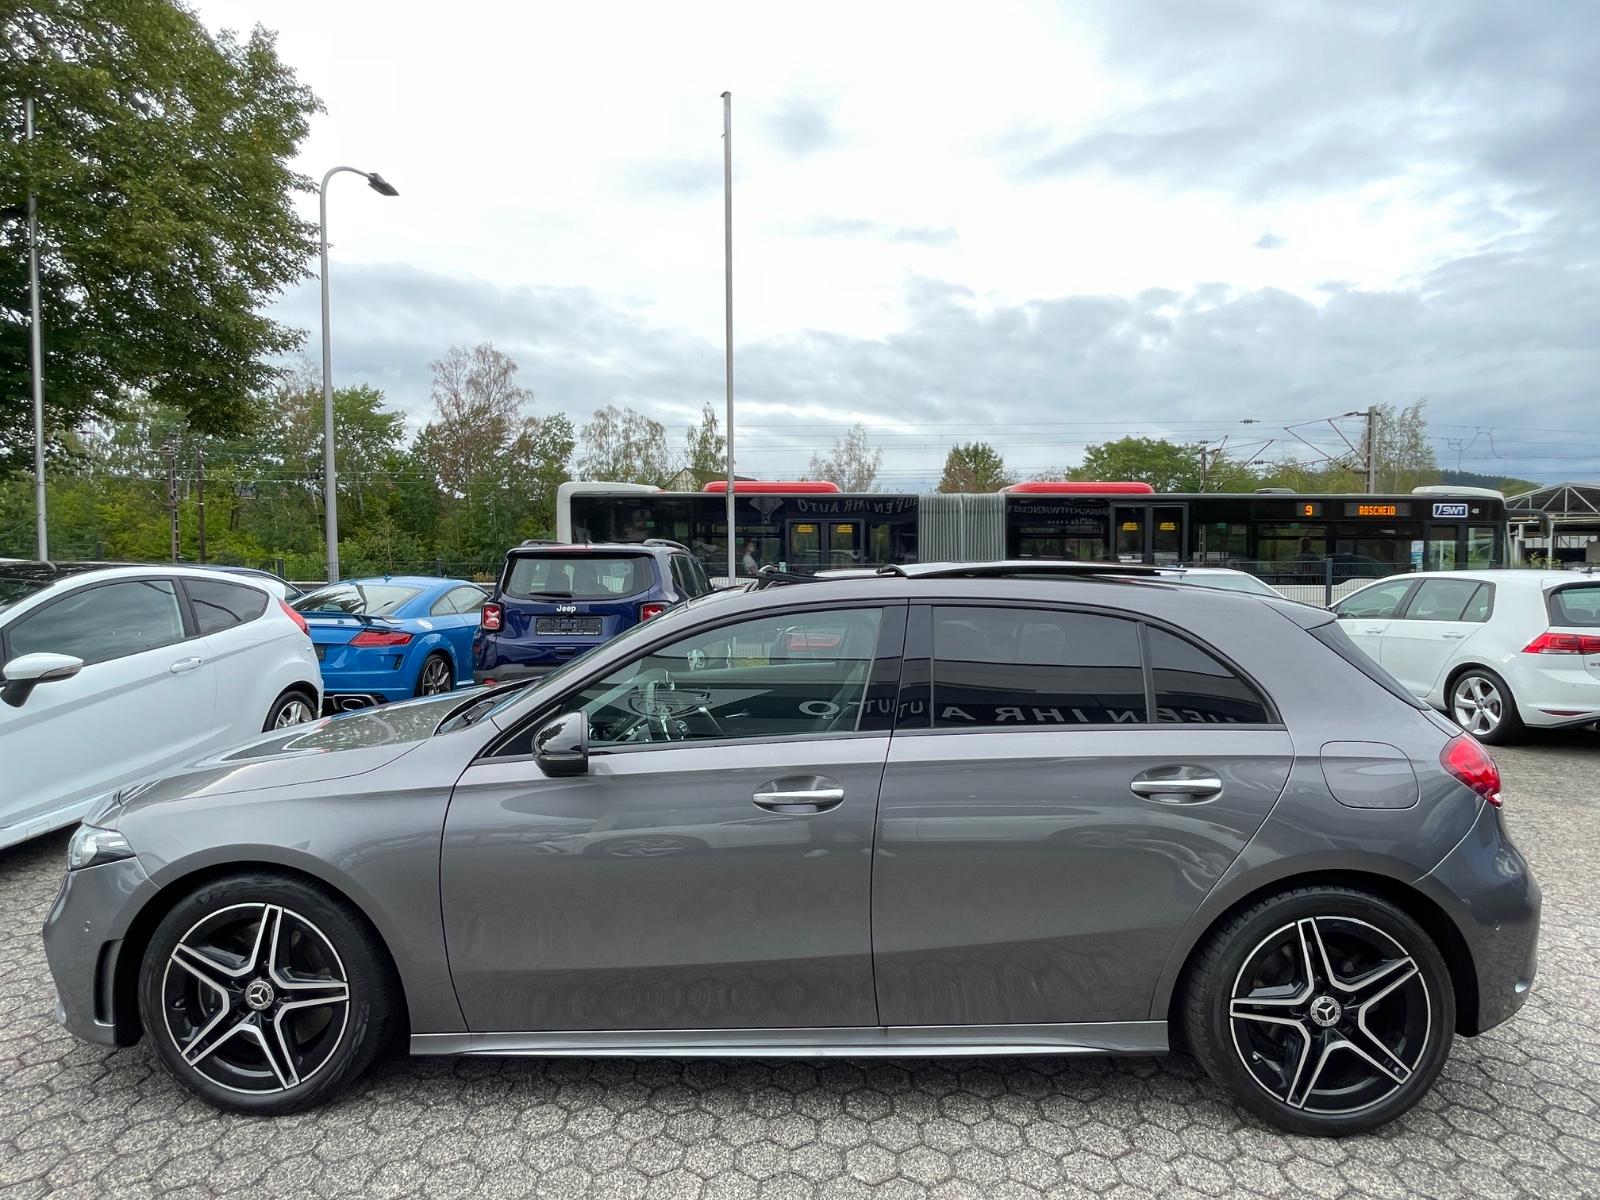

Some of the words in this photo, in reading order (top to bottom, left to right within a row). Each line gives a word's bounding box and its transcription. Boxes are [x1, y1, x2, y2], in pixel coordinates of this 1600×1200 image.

[1305, 505, 1313, 516] 9
[1441, 505, 1465, 515] SWT
[556, 604, 577, 613] Jeep
